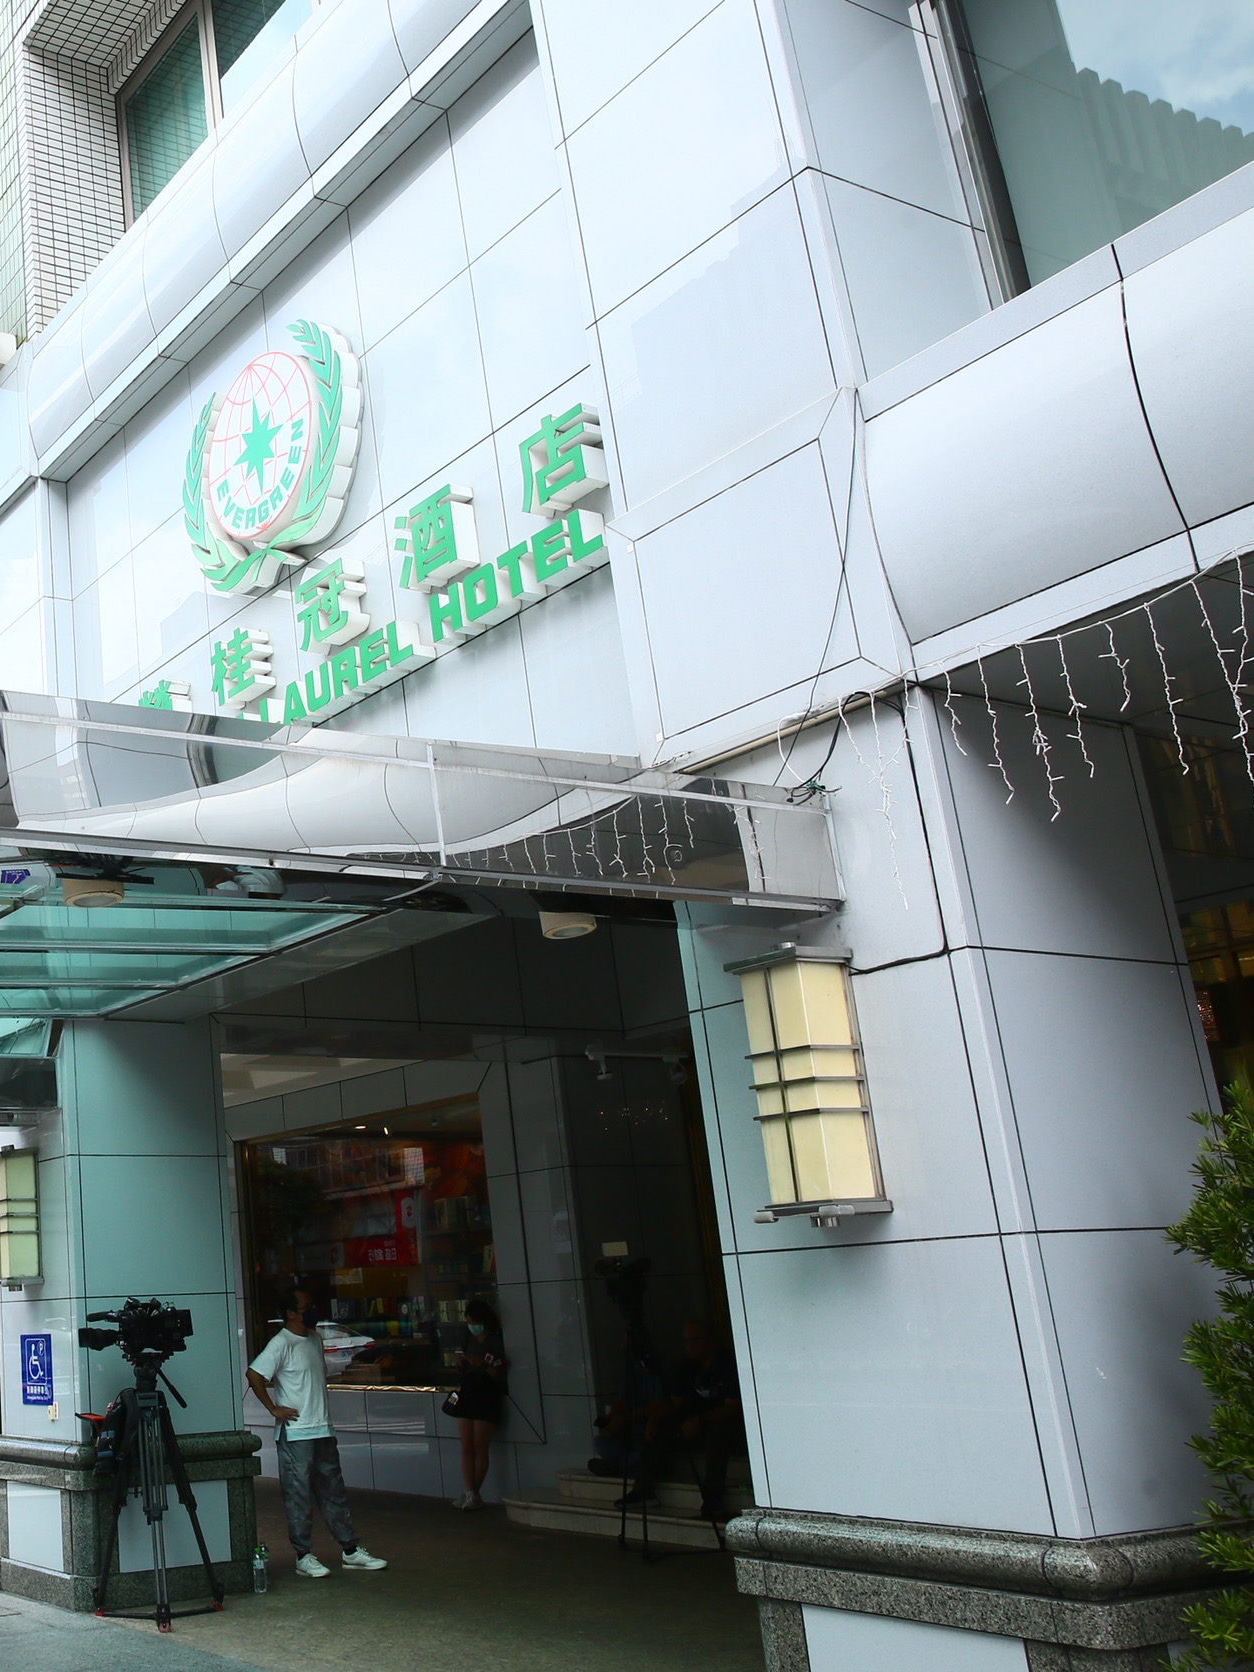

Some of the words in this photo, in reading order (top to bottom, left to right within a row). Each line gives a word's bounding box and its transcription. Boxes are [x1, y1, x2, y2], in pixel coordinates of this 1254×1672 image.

[217, 418, 304, 530] EVERGREEN
[259, 620, 414, 725] LAUREL
[430, 509, 604, 643] HOTEL
